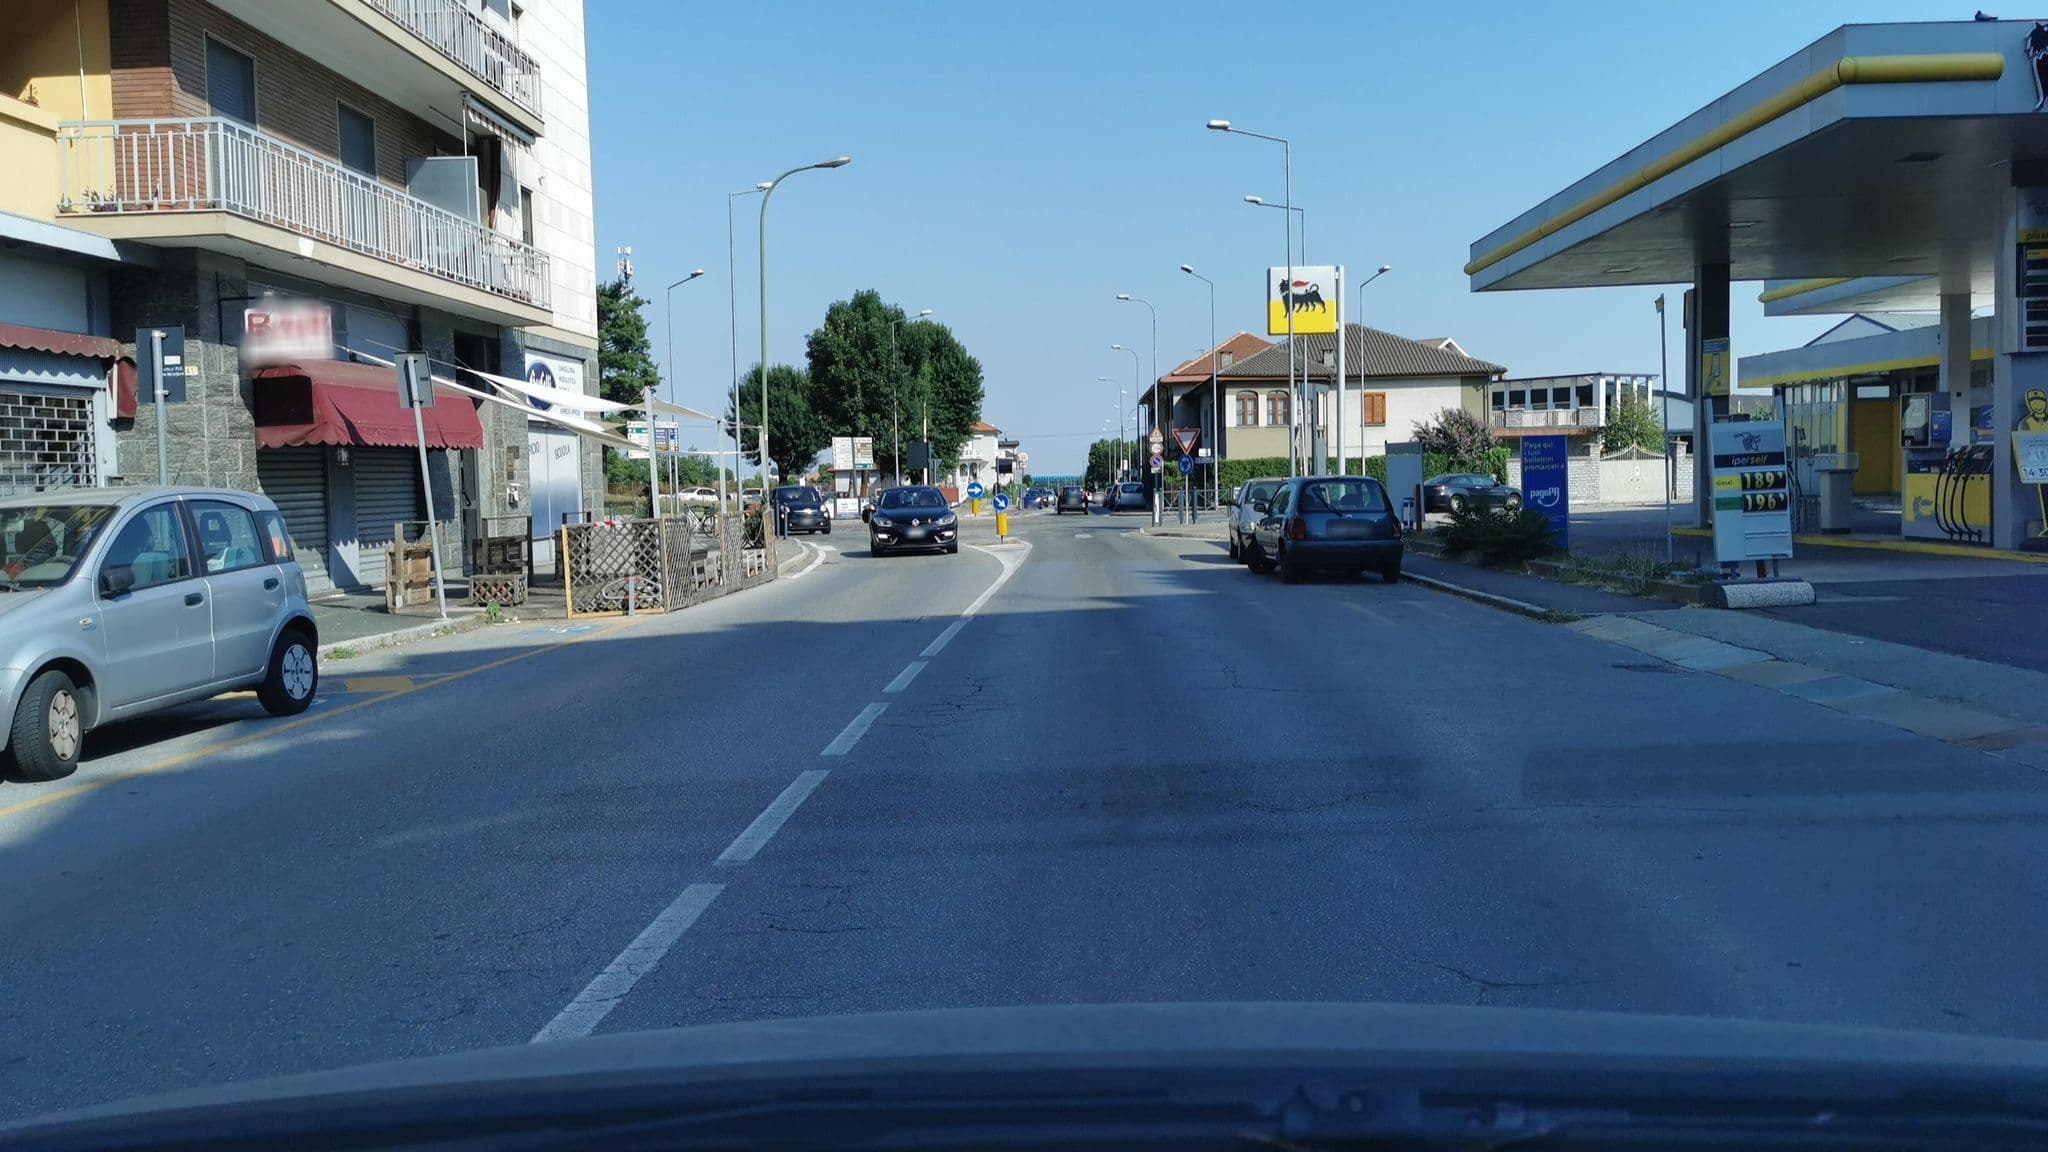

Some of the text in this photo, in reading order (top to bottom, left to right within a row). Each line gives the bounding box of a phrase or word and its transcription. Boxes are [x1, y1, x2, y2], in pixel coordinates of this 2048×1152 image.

[1524, 441, 1554, 450] Paga qui
[1731, 454, 1769, 466] iperself
[1524, 463, 1560, 472] premarcati
